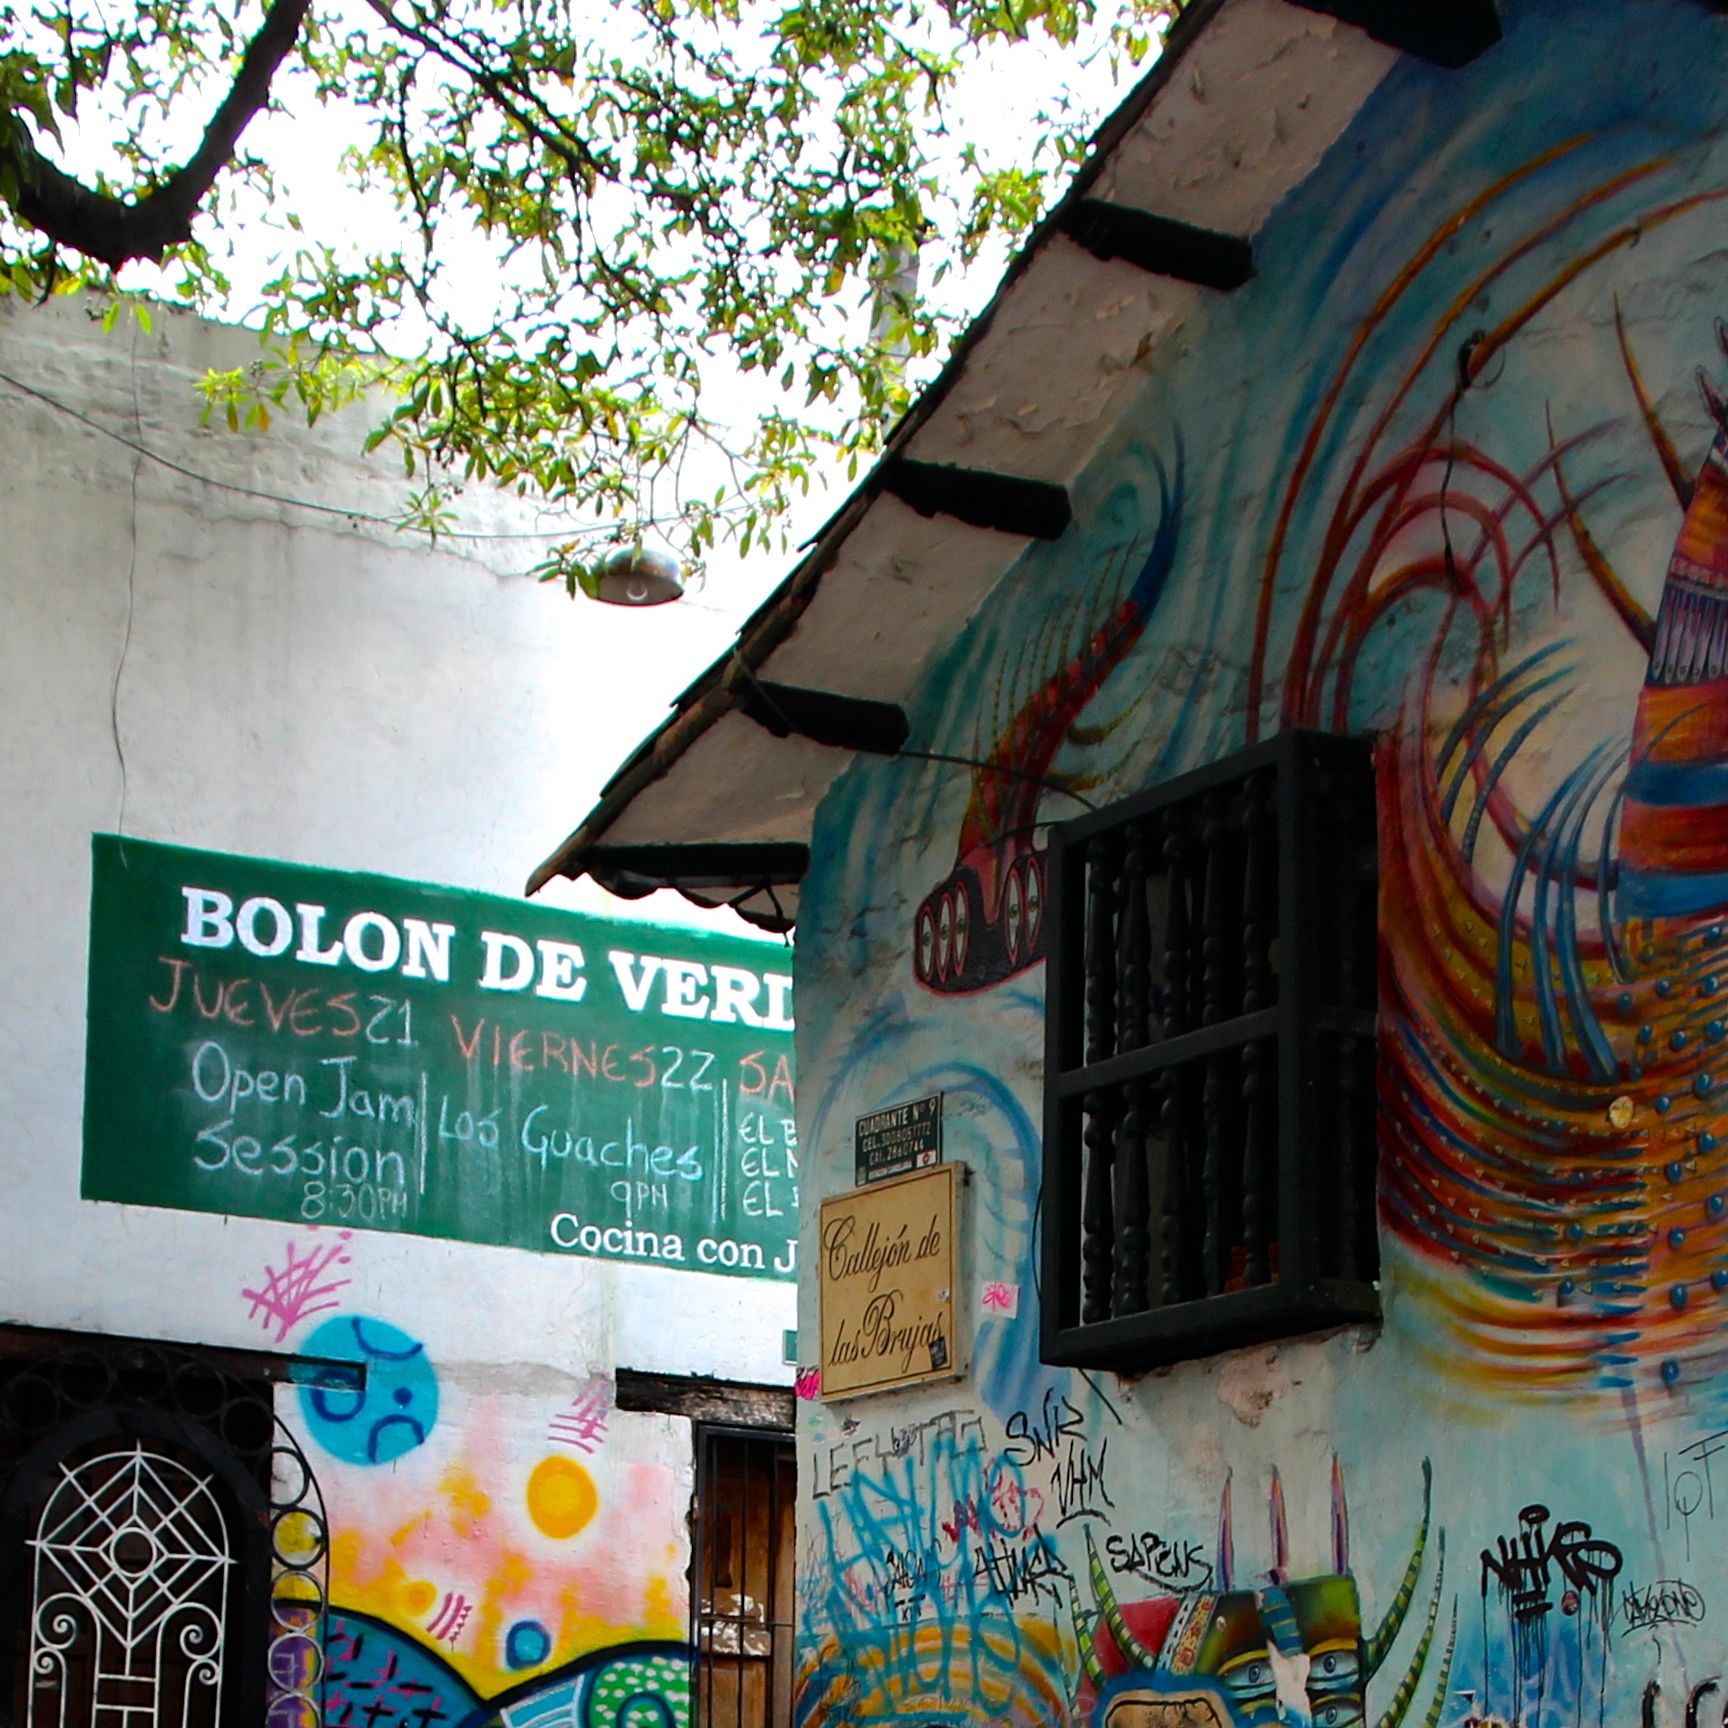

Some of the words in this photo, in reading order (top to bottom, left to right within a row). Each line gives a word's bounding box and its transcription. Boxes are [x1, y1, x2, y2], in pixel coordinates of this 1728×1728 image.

[180, 886, 456, 983] BOLON
[478, 930, 587, 1001] DE
[149, 956, 361, 1037] JUEVES
[450, 1013, 657, 1088] VIERNES
[192, 1040, 307, 1114] Open
[319, 1055, 417, 1126] Jam
[194, 1119, 405, 1187] Session
[522, 1104, 703, 1181] Guaches
[549, 1213, 685, 1268] Cocina
[697, 1239, 766, 1269] con
[823, 1215, 912, 1293] Callejón
[916, 1214, 941, 1260] de
[828, 1319, 860, 1367] las
[861, 1289, 944, 1374] Brujas
